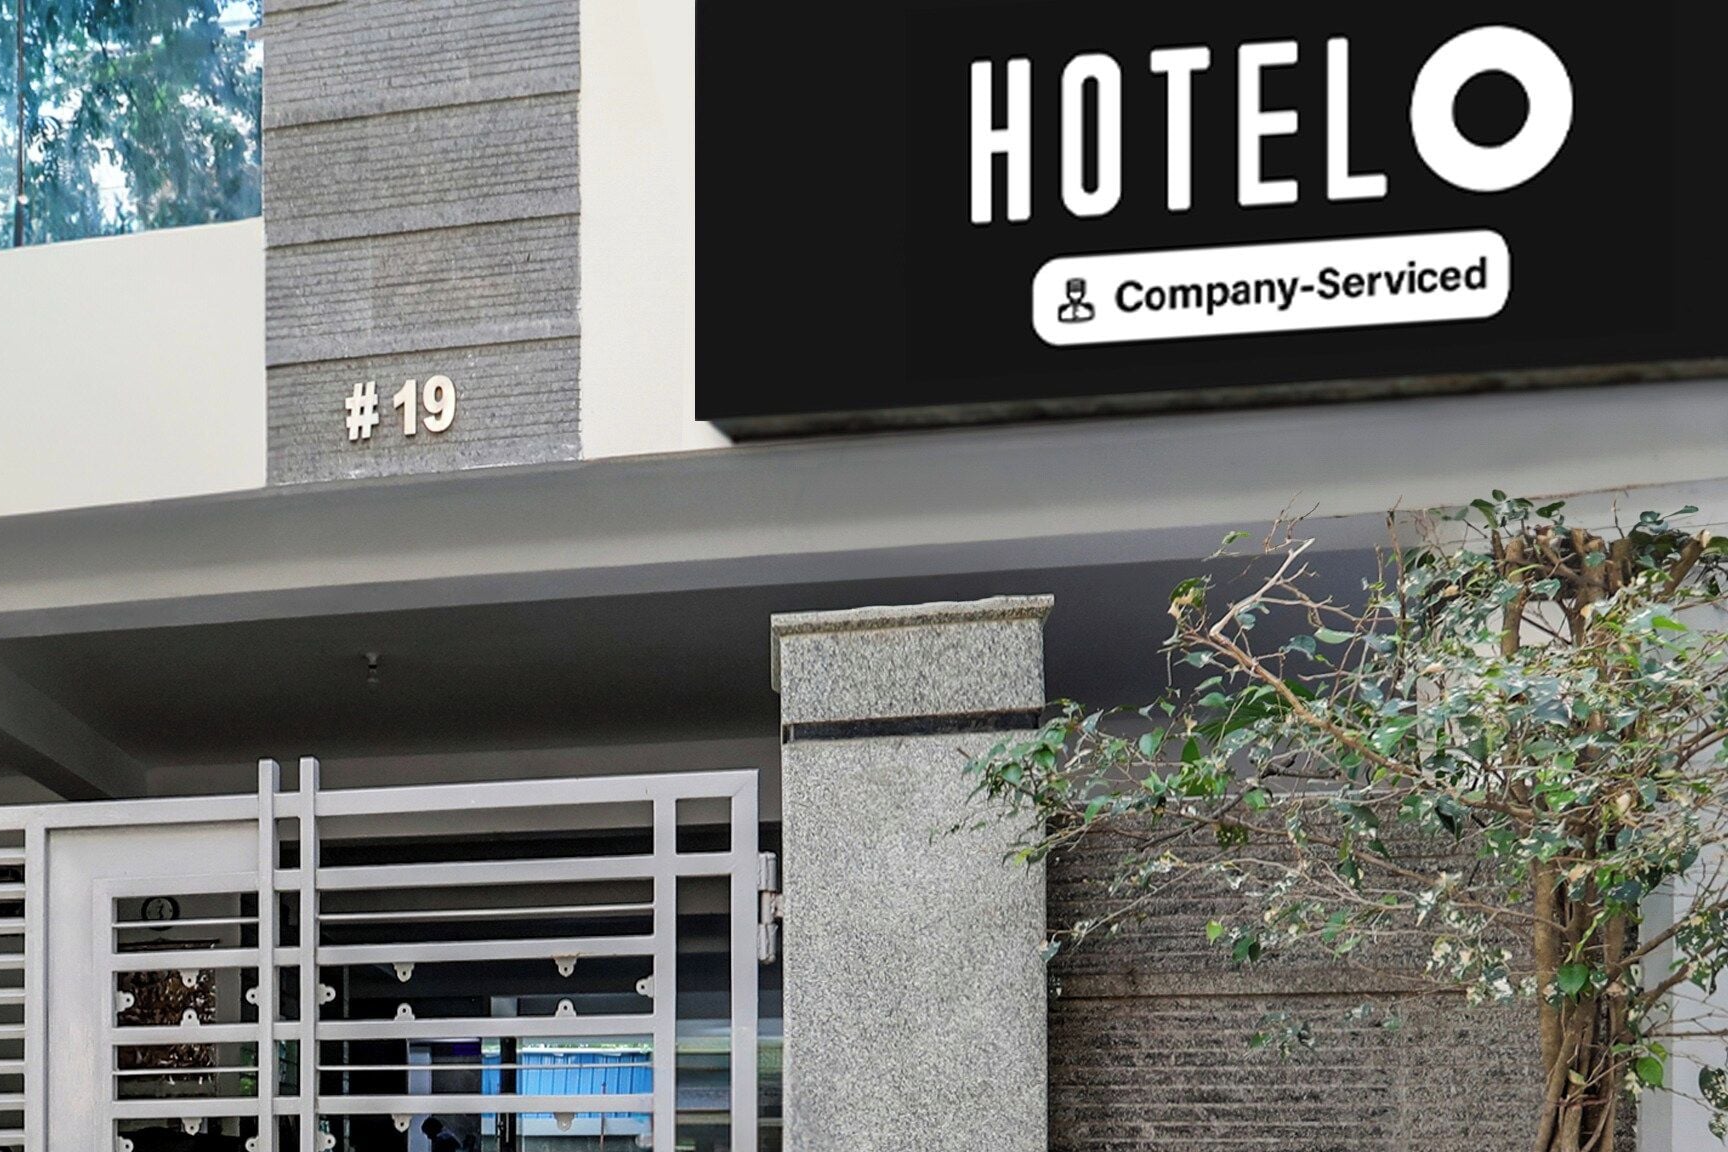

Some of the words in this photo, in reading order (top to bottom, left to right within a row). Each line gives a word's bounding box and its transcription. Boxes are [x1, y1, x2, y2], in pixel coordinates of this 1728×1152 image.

[971, 37, 1387, 224] HOTEL
[1410, 25, 1573, 192] O
[1115, 256, 1487, 316] Company-Serviced
